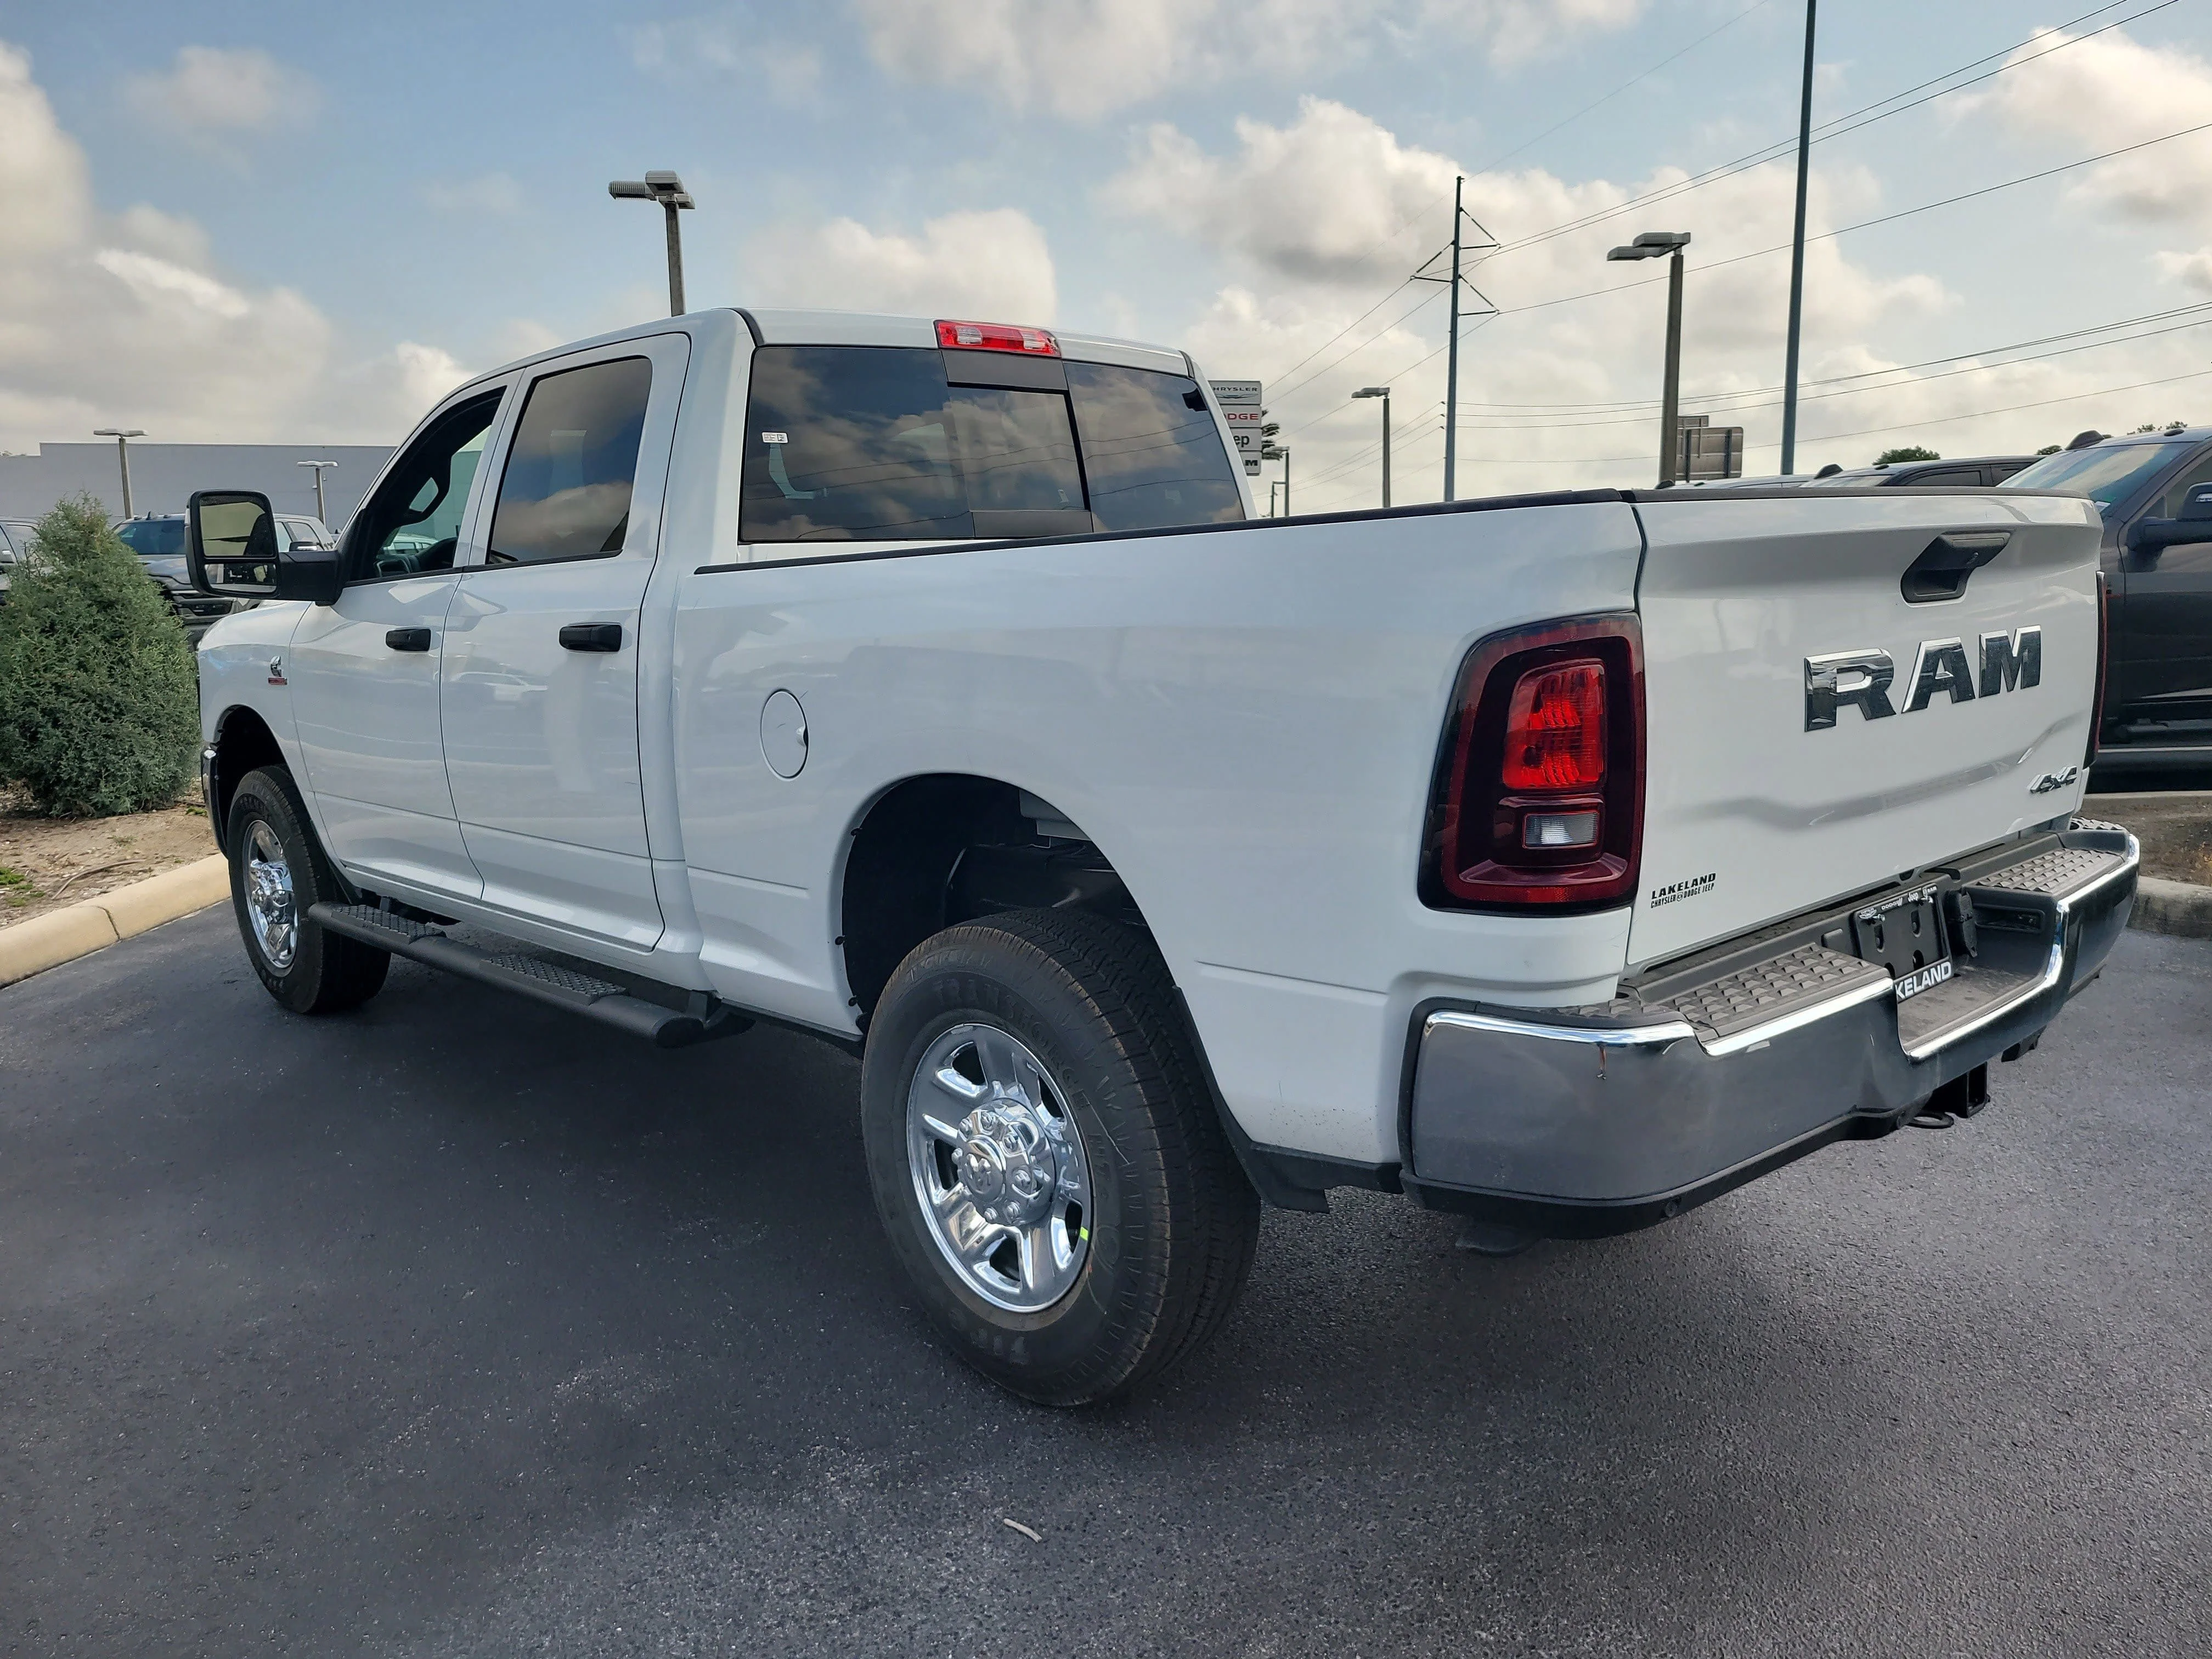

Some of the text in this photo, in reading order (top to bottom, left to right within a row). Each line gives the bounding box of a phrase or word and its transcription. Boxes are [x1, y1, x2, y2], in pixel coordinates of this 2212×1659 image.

[1233, 435, 1250, 447] ep
[1804, 624, 2041, 732] RAM
[1651, 873, 1716, 900] LAKELAND
[1651, 883, 1714, 909] CHRYSLER DODGE JEEP
[1895, 961, 1952, 1000] KELAND
